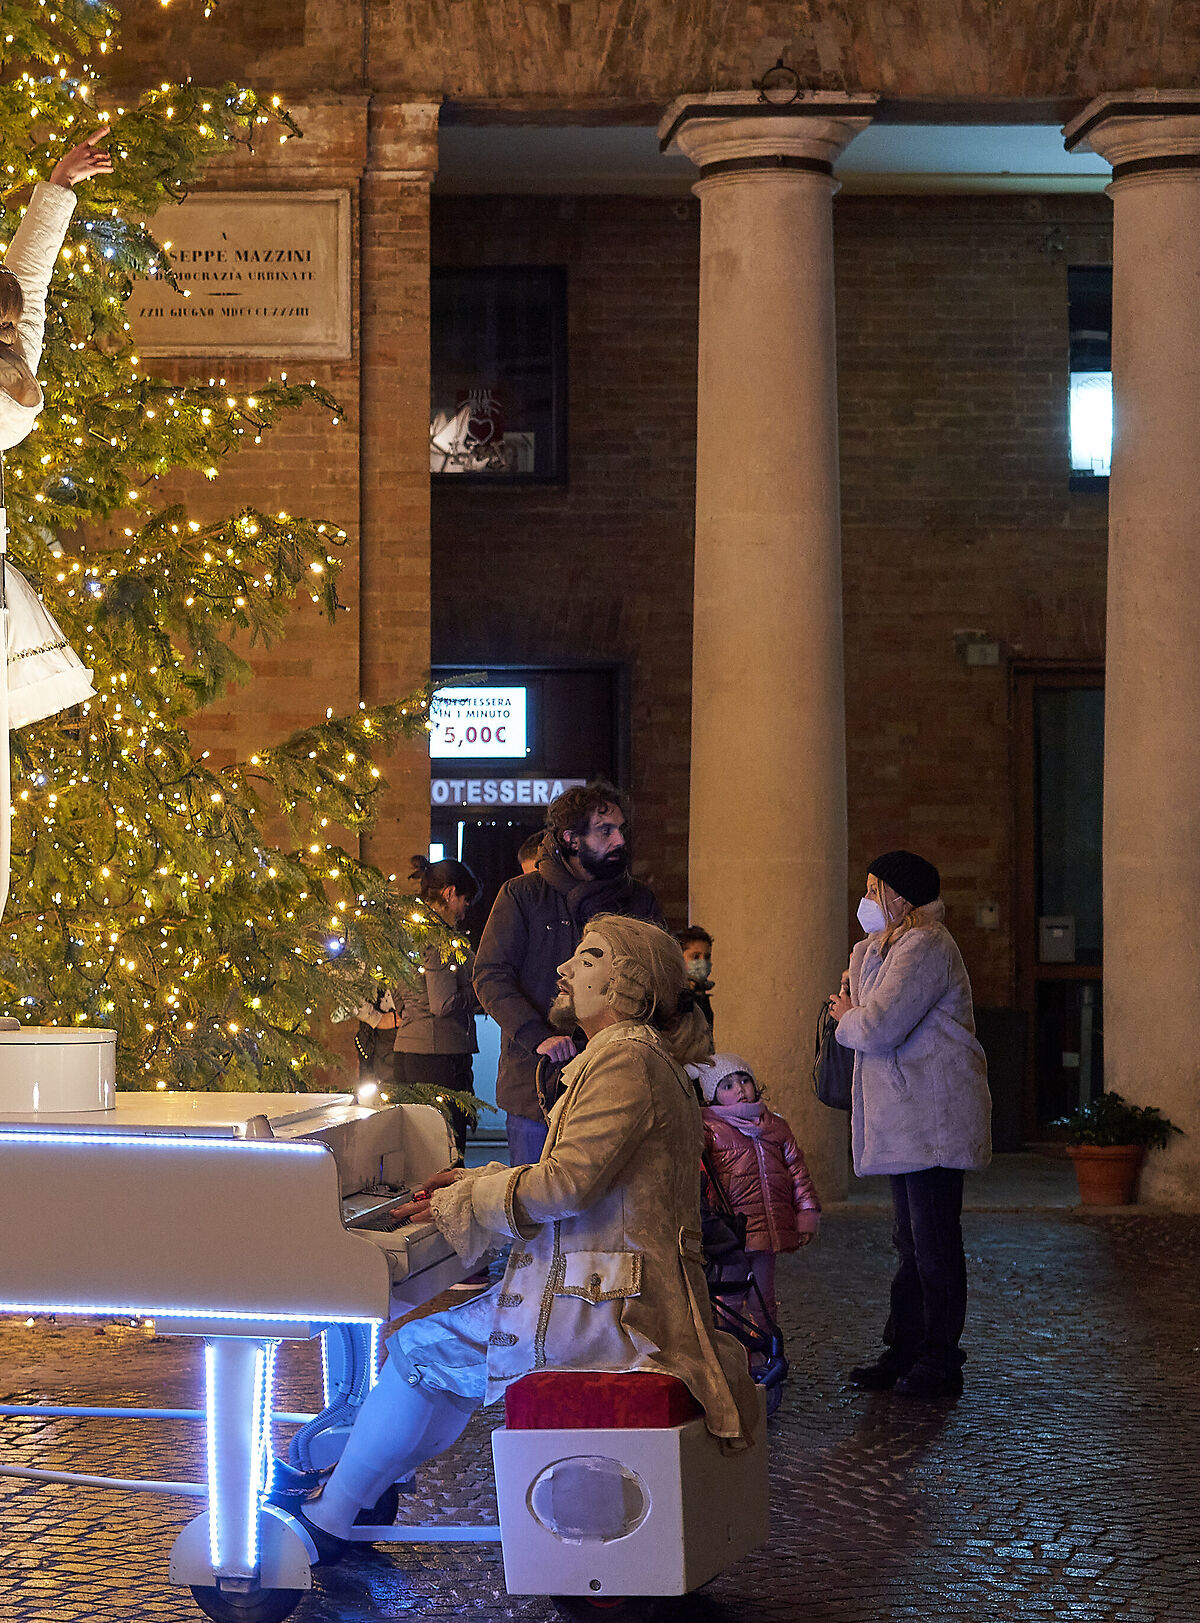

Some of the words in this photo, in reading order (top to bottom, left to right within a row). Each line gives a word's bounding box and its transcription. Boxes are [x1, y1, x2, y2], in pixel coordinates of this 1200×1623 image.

[235, 250, 311, 262] MAZZINI
[248, 272, 316, 281] URBINATE
[170, 308, 214, 317] GIUGNO
[439, 709, 451, 718] IN
[466, 710, 511, 718] MINUTO
